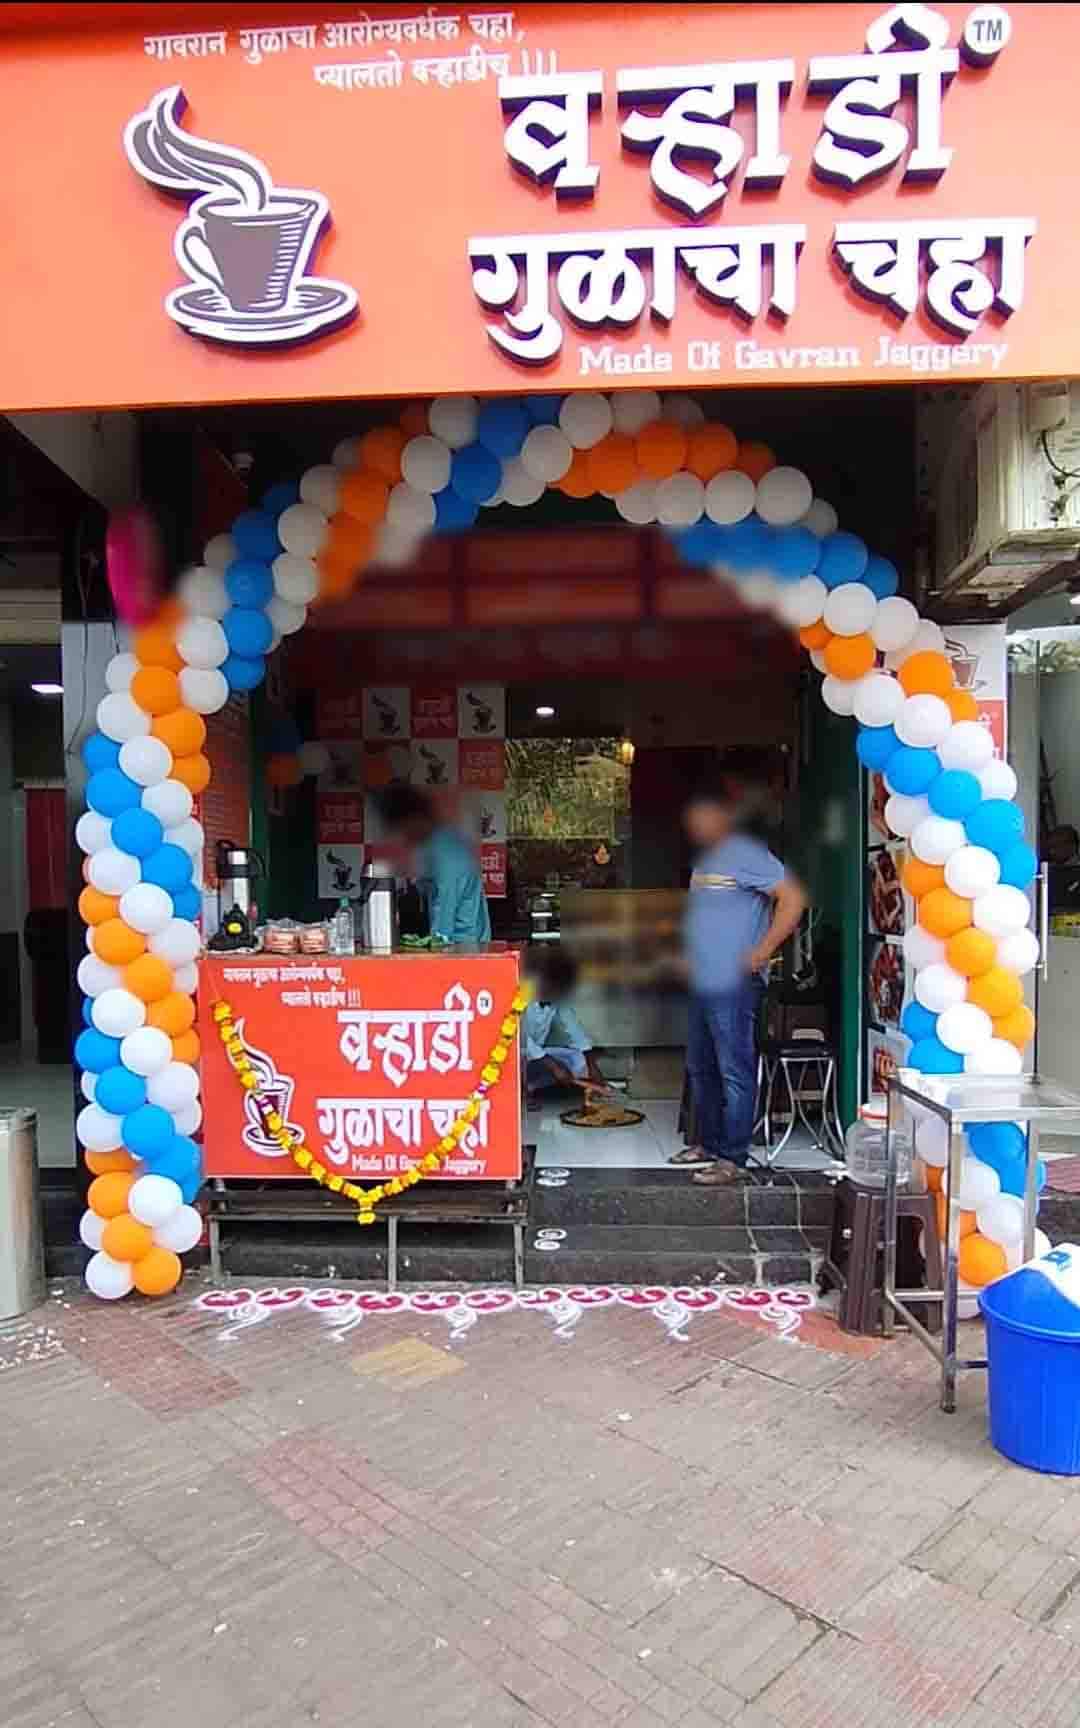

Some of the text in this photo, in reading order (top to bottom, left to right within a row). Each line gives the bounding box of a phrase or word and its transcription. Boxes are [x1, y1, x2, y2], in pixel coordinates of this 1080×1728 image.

[143, 31, 226, 59] गावरान
[239, 25, 317, 64] गुळाचा
[972, 18, 1003, 42] TM
[467, 217, 1037, 364] गुळाचा चहा
[579, 335, 1009, 376] Made Of Gavran Jaggery
[316, 1098, 424, 1164] गुळाचा
